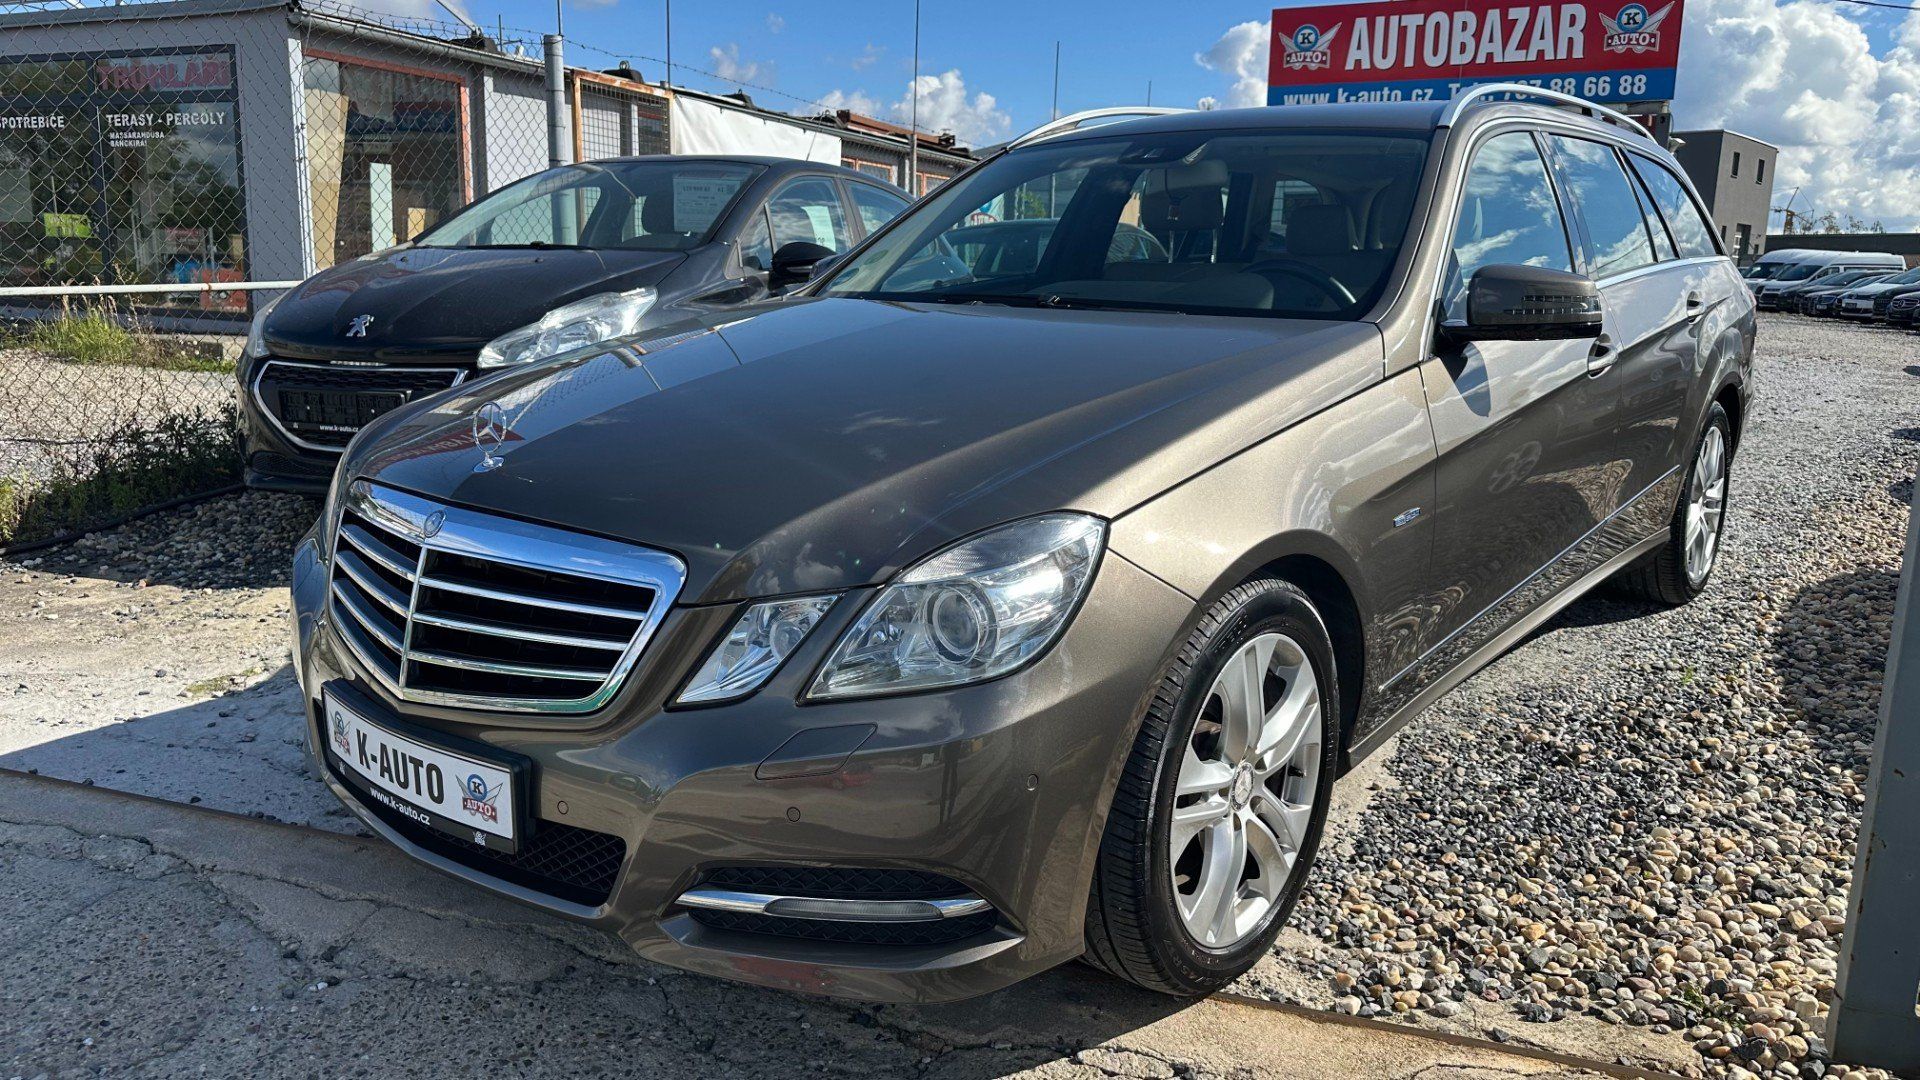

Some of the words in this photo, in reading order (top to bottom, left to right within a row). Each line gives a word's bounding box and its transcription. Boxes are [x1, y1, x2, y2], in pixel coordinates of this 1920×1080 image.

[1624, 11, 1640, 26] K
[1300, 32, 1313, 45] K
[1345, 3, 1588, 70] AUTOBAZAR
[1611, 33, 1650, 46] AUTO
[1289, 51, 1322, 63] AUTO
[1583, 76, 1611, 97] 66
[1619, 74, 1647, 95] 88
[105, 113, 154, 127] TERASY
[166, 111, 225, 126] PERGOLY
[356, 728, 445, 805] K-AUTO
[471, 781, 483, 795] K
[369, 787, 431, 826] www.k-auto.cz
[466, 799, 492, 816] AUTO
